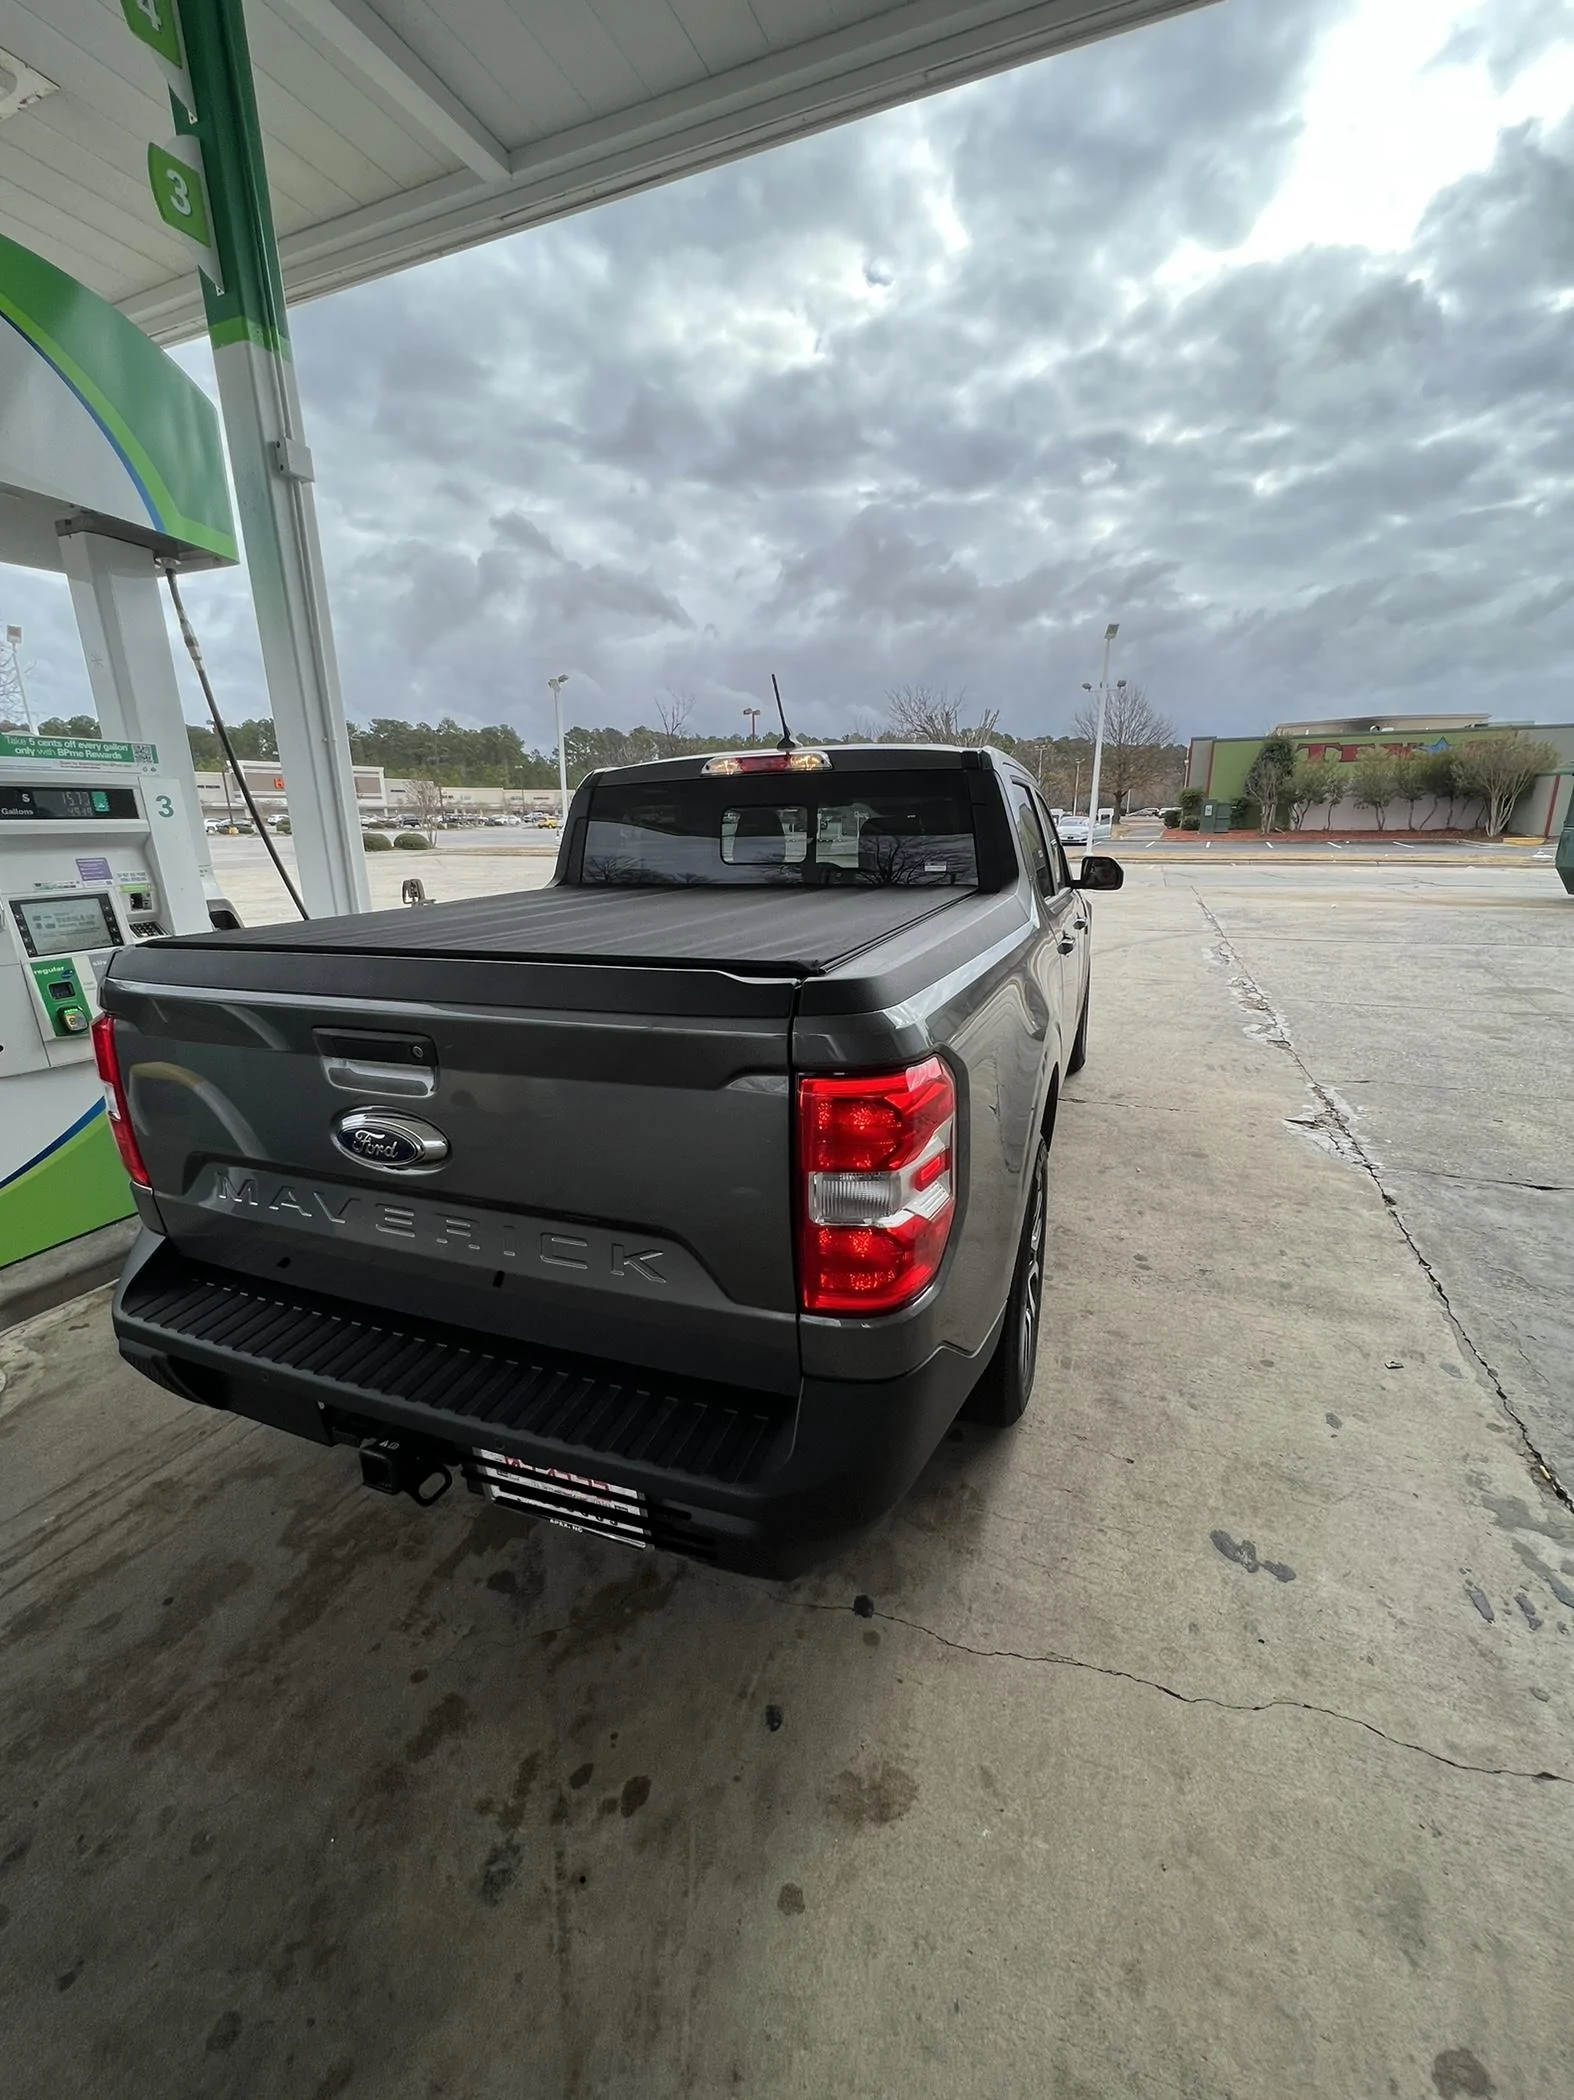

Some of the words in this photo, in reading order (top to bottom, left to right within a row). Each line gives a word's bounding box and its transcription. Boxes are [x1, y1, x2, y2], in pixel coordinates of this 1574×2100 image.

[166, 168, 192, 216] 3
[15, 746, 35, 756] only
[36, 747, 56, 756] with
[57, 748, 84, 757] BPme
[85, 750, 122, 759] Rewards
[29, 737, 35, 746] 5
[64, 740, 76, 748] off
[79, 742, 101, 751] every
[103, 743, 128, 751] gallon
[1, 807, 34, 815] Gallons
[156, 795, 174, 818] 3
[34, 966, 64, 975] regular
[352, 1130, 399, 1158] Ford
[215, 1171, 667, 1283] MAVERICK
